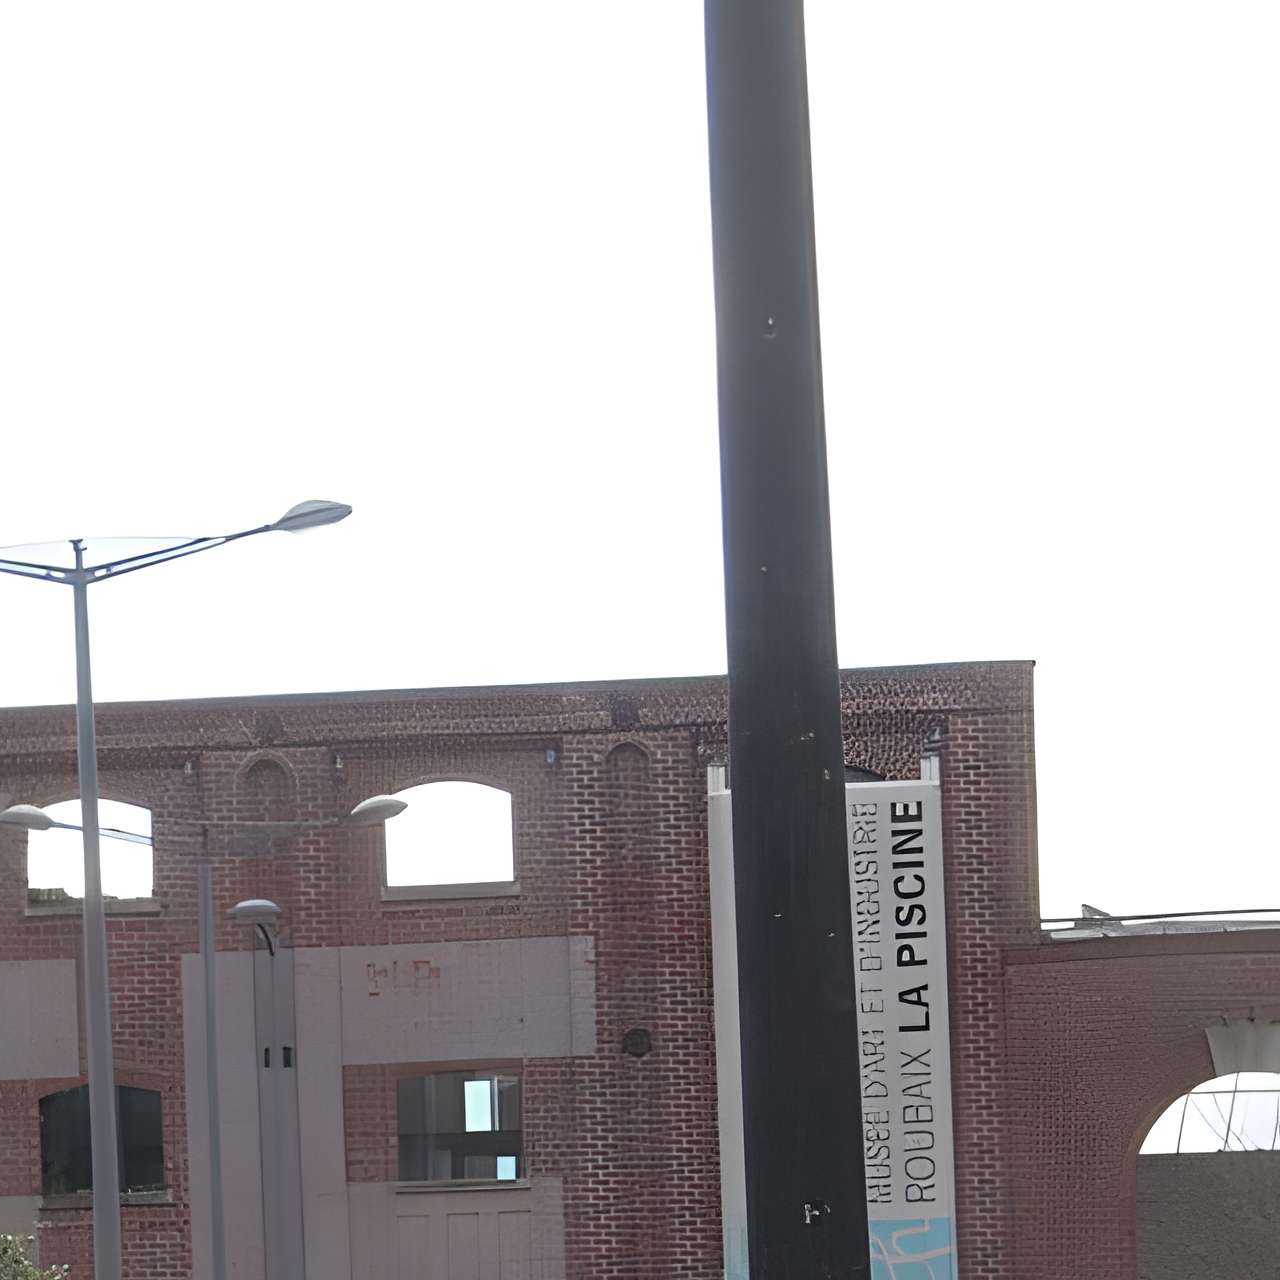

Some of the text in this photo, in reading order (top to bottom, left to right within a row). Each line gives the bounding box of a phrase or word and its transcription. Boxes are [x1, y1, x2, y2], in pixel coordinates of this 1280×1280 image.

[860, 981, 884, 1014] ET
[890, 800, 936, 1204] ROUBAIX LA PISCINE
